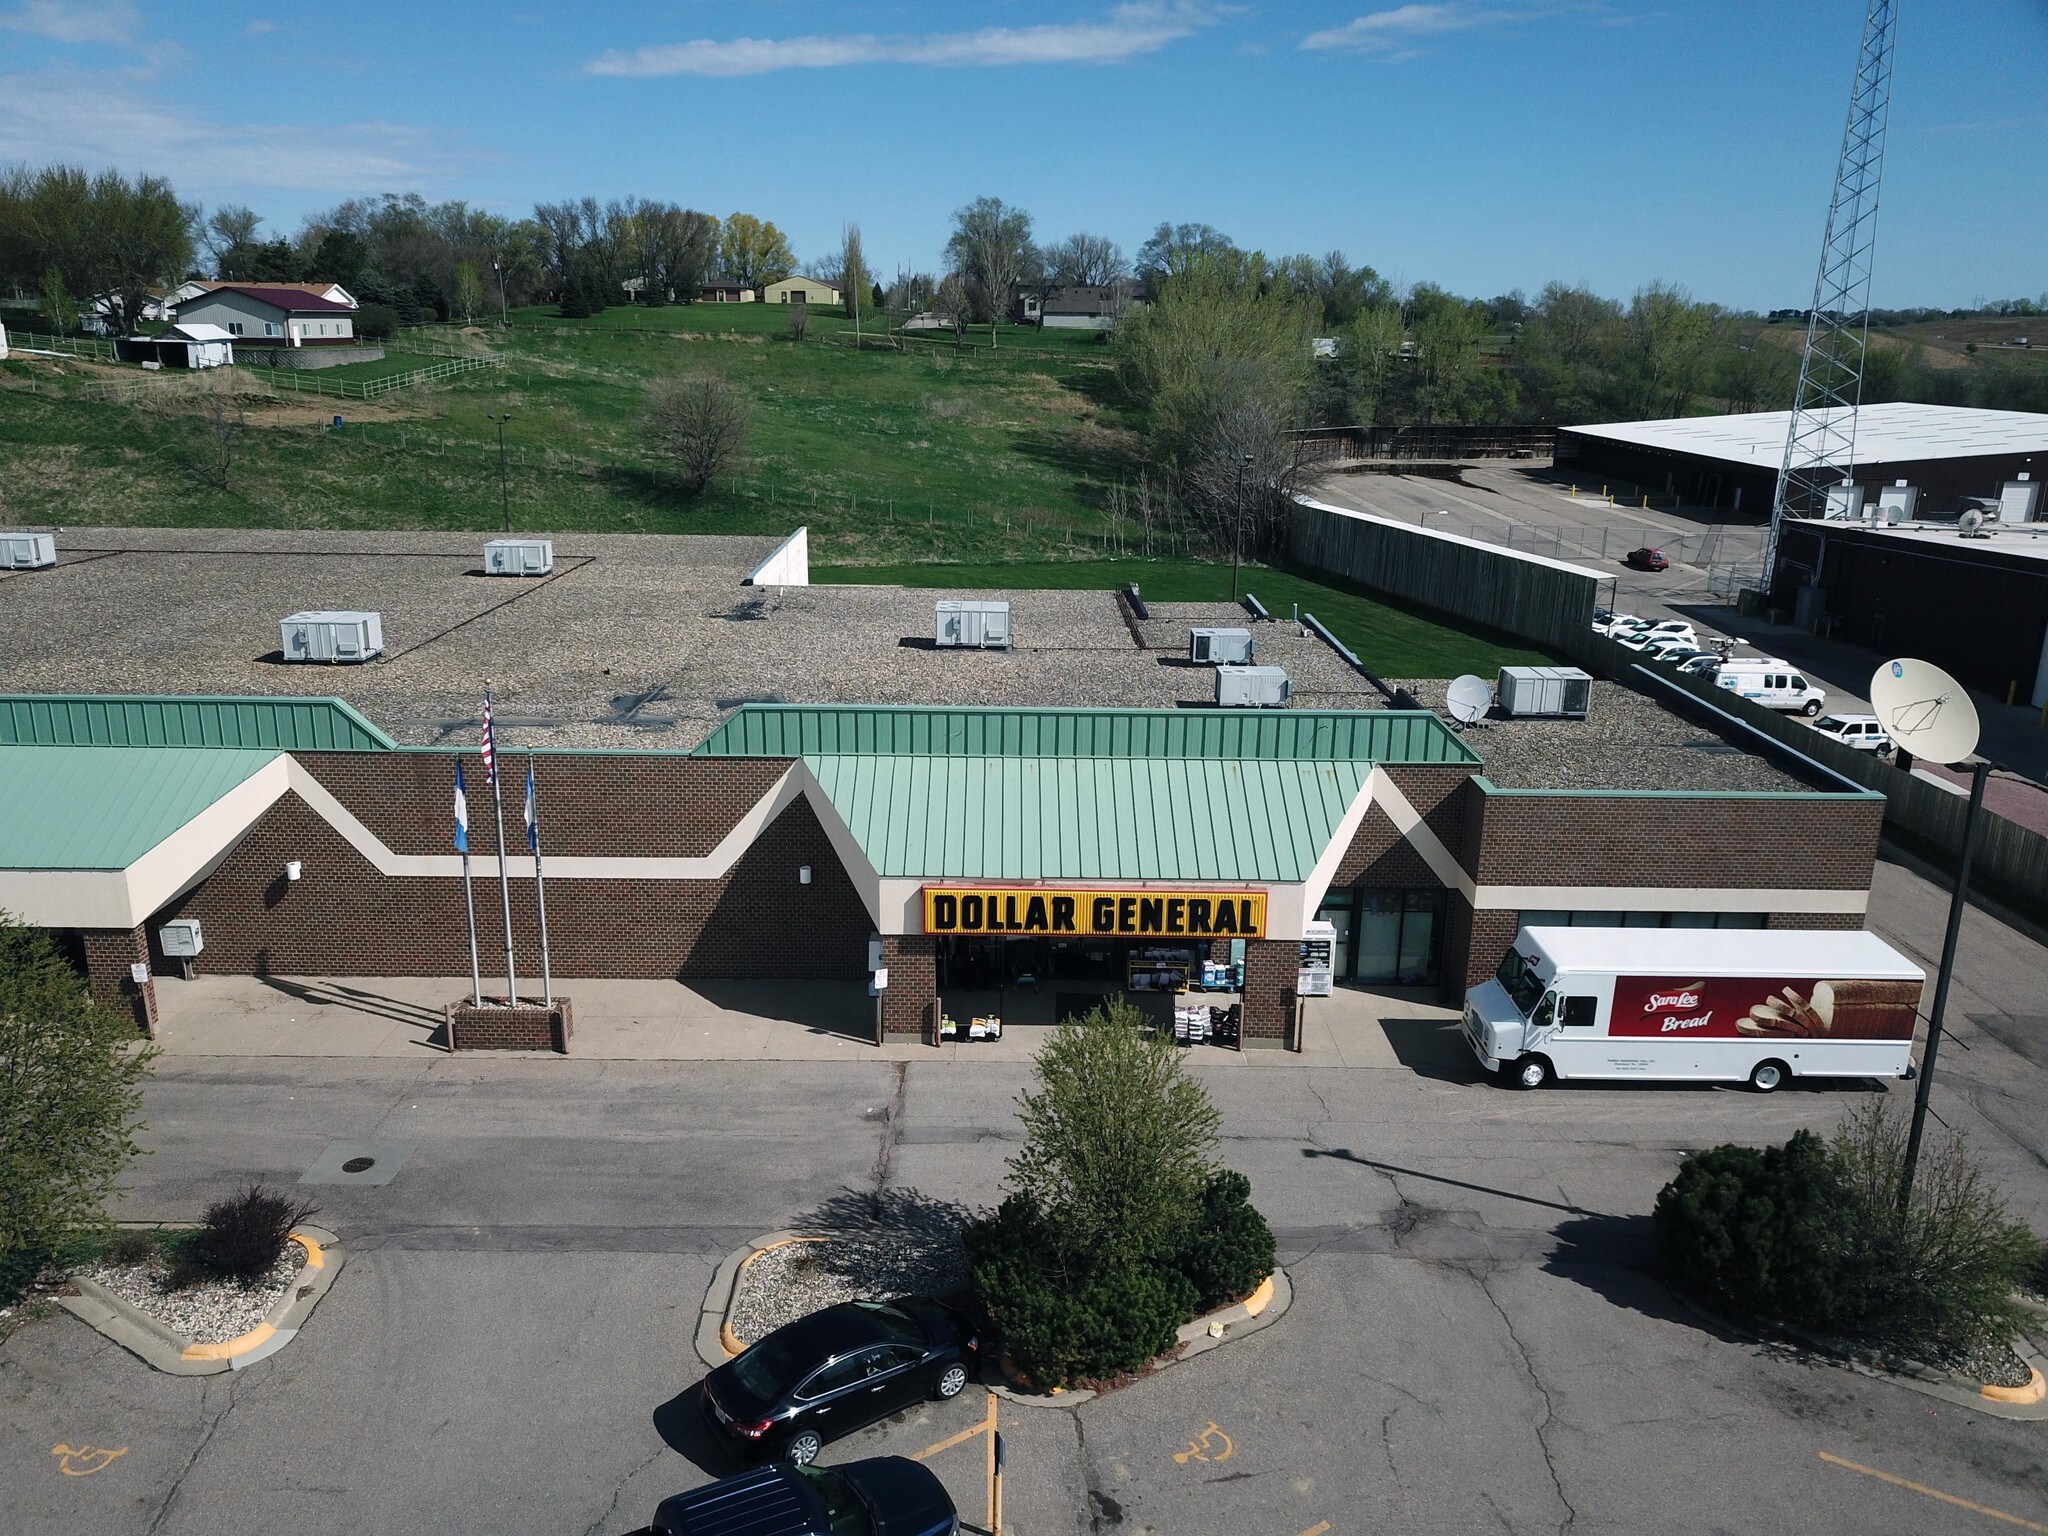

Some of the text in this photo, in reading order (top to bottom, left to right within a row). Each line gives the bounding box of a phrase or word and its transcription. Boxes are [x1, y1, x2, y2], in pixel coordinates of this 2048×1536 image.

[934, 894, 1258, 934] DOLLAR GENERAL
[1644, 992, 1699, 1012] Sara Lee
[1661, 1010, 1713, 1032] Bread
